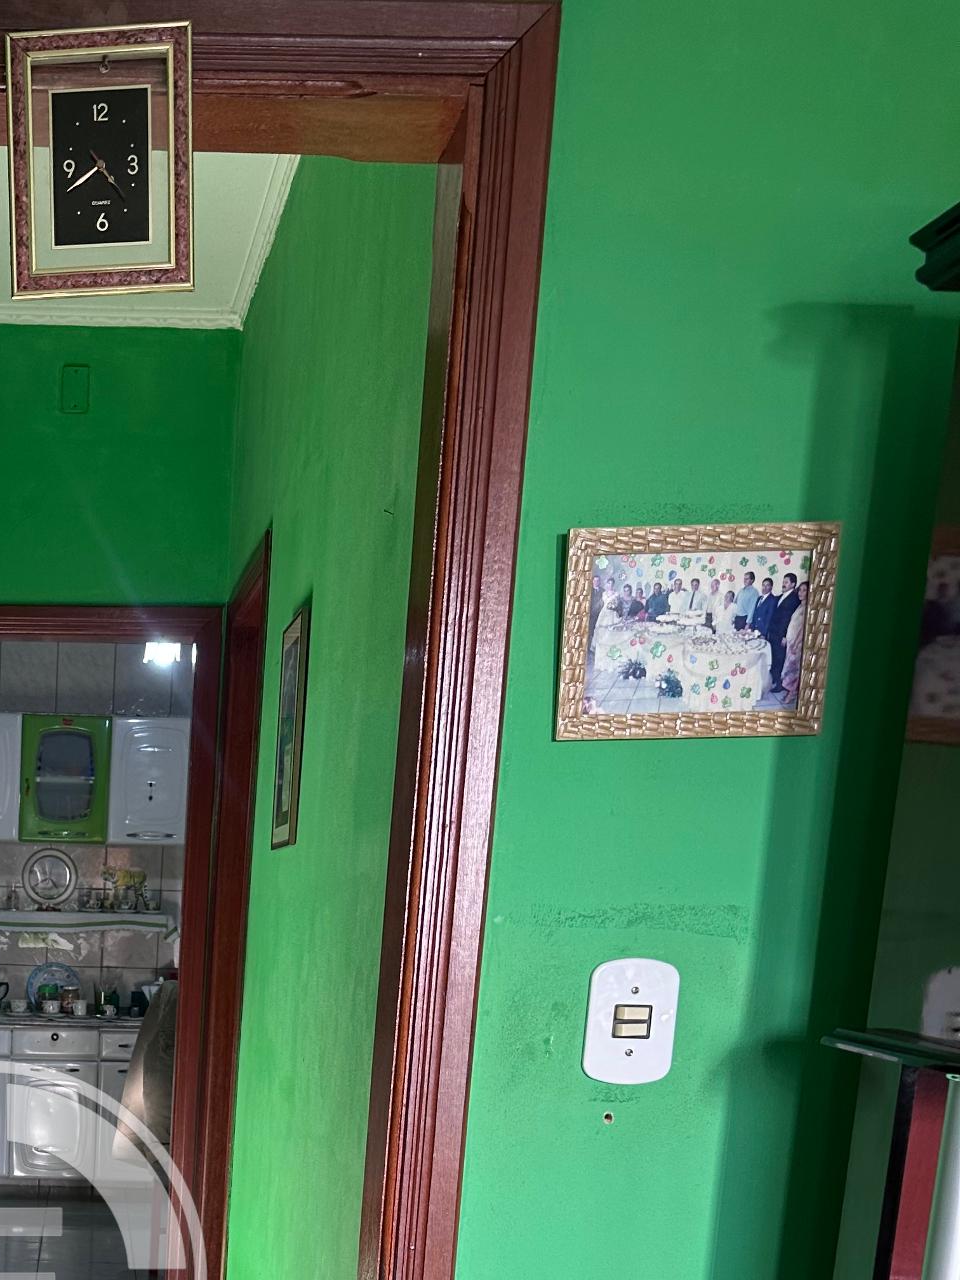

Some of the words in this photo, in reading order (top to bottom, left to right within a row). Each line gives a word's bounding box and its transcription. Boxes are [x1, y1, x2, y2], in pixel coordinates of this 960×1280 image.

[93, 104, 109, 121] 12
[63, 159, 76, 178] 9
[127, 154, 139, 176] 3
[96, 212, 109, 232] 6
